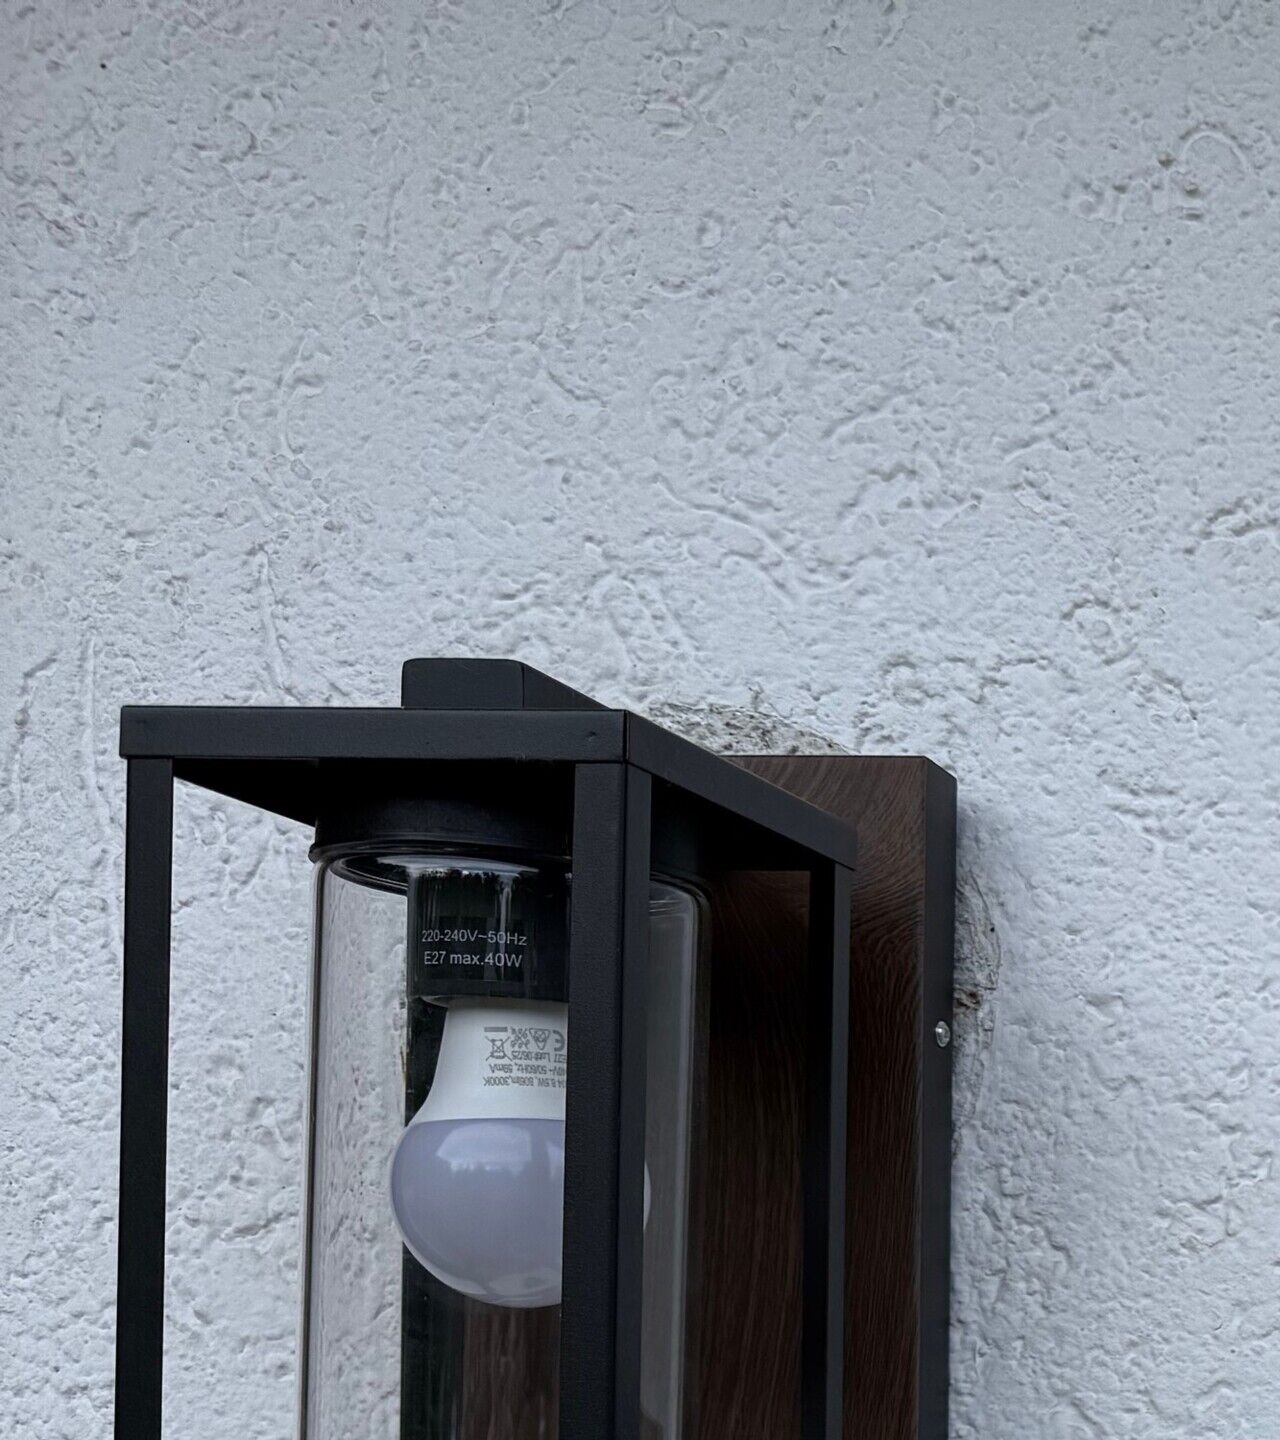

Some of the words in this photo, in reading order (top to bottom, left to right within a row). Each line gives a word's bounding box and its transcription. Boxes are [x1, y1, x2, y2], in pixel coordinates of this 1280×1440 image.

[421, 929, 528, 946] 220-240V~50Hz
[424, 951, 447, 965] E27
[449, 952, 523, 968] max.40W
